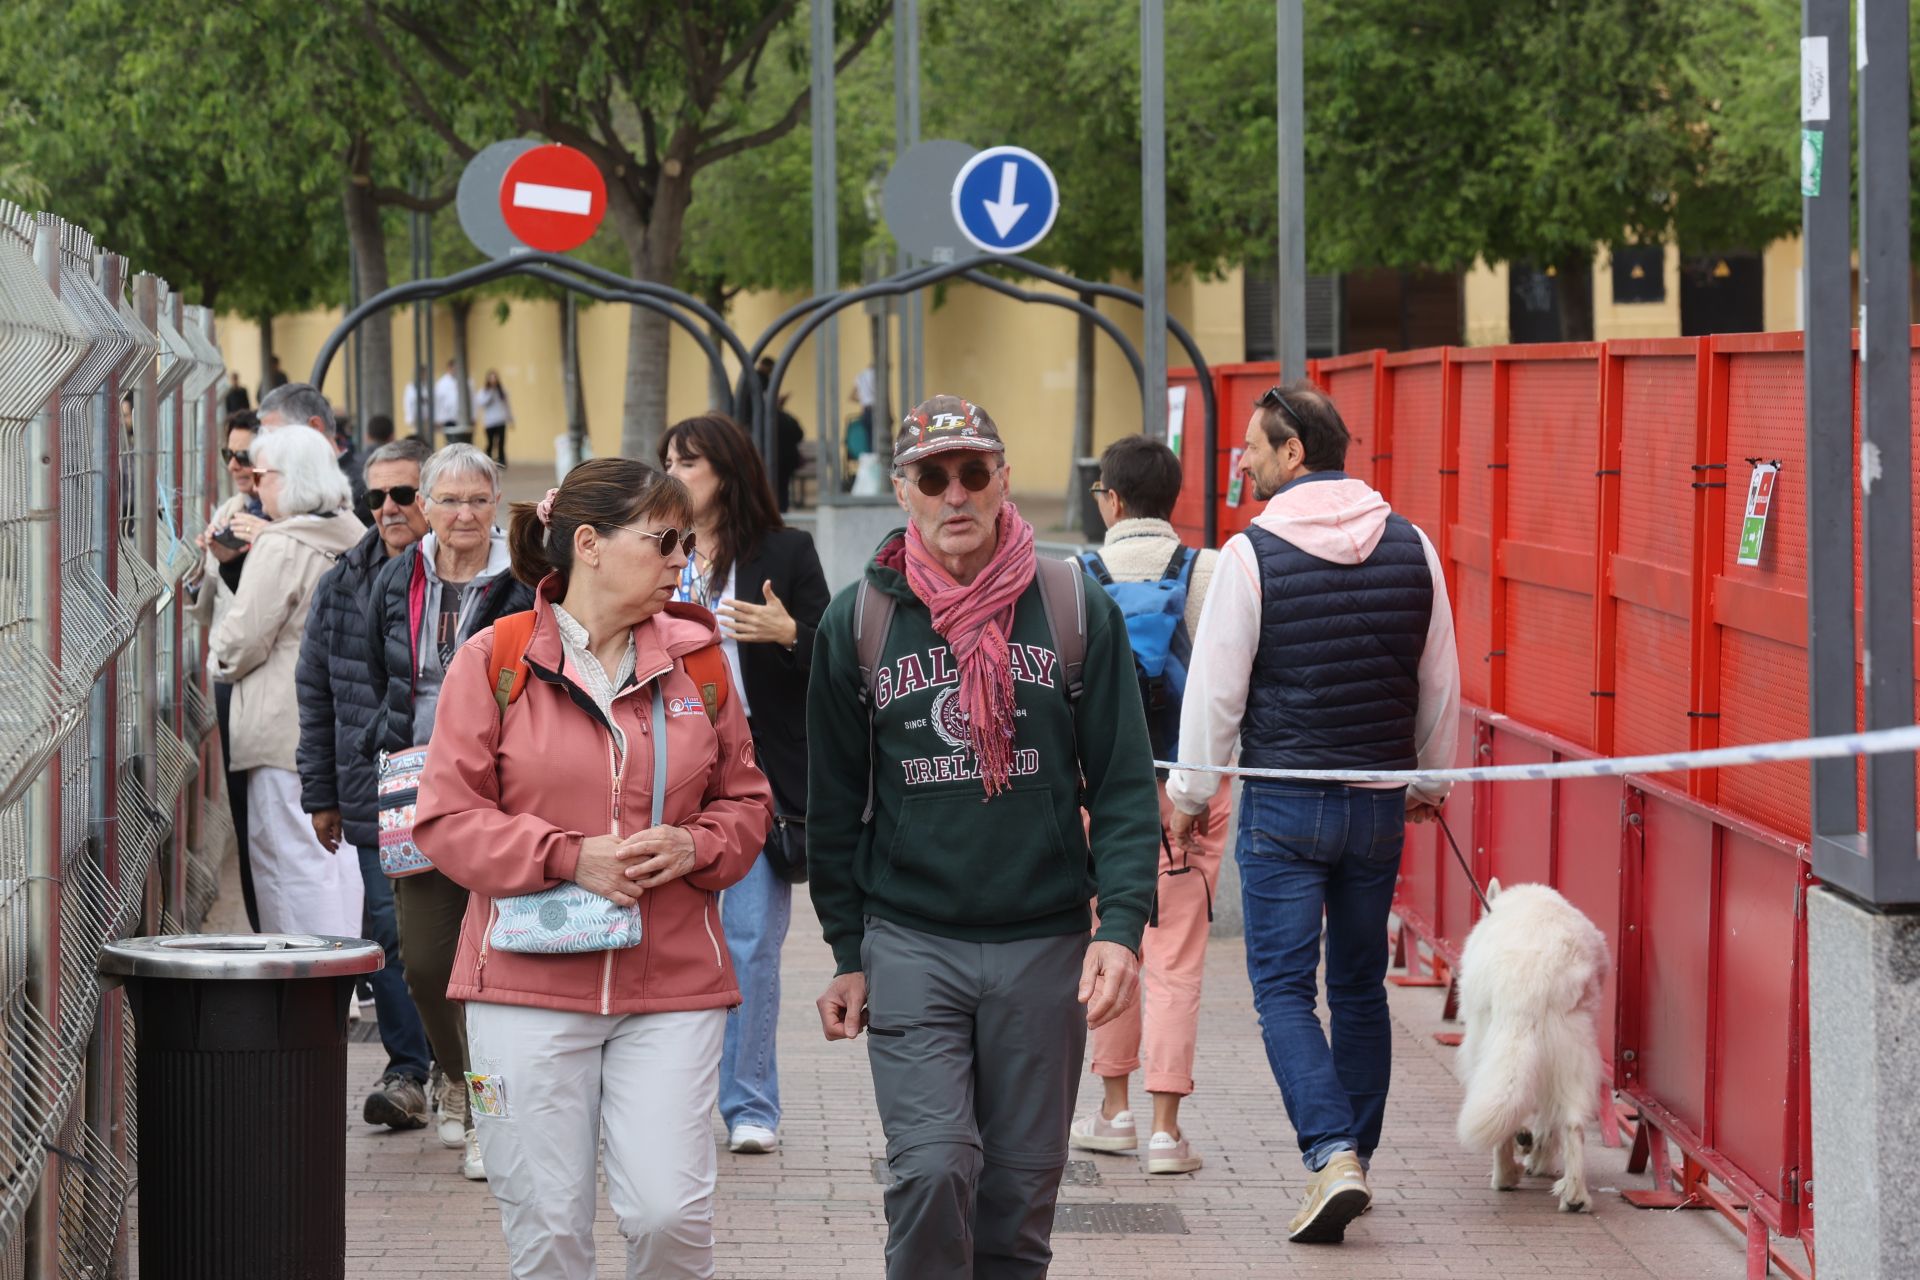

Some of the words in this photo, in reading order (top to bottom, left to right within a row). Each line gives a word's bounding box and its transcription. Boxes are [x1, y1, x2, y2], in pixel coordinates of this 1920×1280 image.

[932, 413, 965, 428] TT
[876, 642, 1057, 709] GALAY
[904, 719, 928, 730] SINCE
